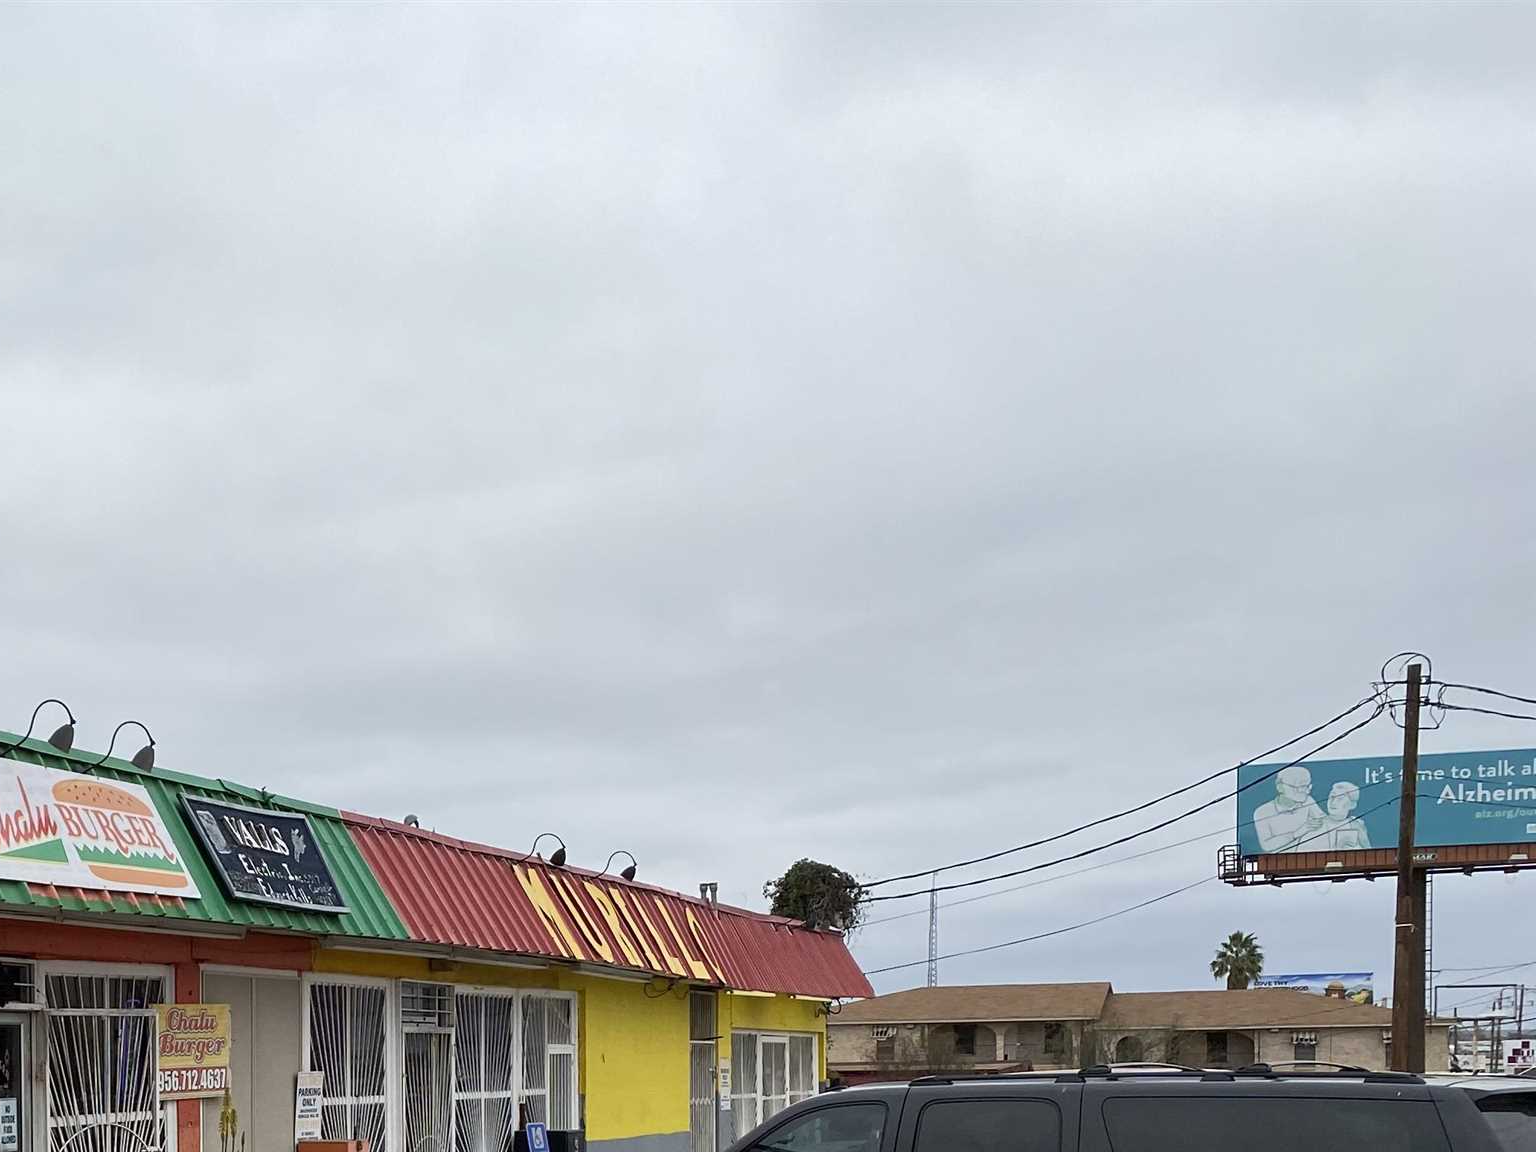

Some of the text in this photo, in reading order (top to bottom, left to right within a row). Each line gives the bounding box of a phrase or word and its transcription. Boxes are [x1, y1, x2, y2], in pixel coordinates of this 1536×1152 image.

[1365, 766, 1393, 784] It's
[1399, 768, 1445, 782] tme
[1451, 765, 1472, 780] to
[1477, 759, 1516, 778] talk
[55, 803, 177, 860] BURGER
[223, 815, 290, 856] VALLS
[167, 1008, 217, 1032] Chalu
[159, 1032, 225, 1063] Burger
[158, 1068, 226, 1092] 956.712.4637
[298, 1087, 321, 1096] PARKING
